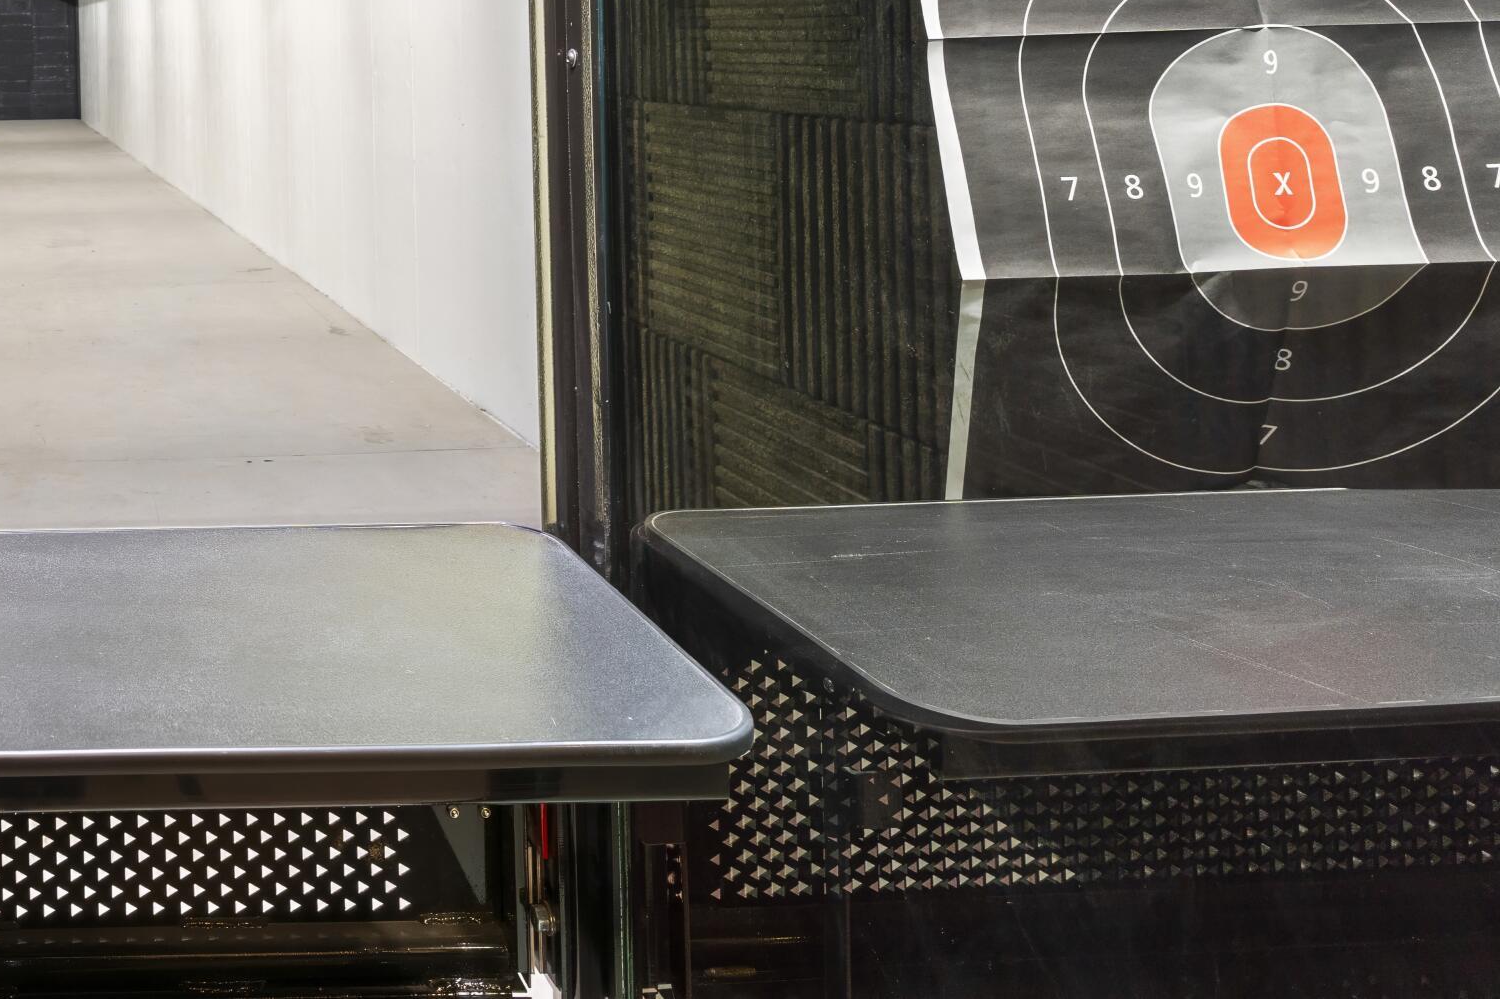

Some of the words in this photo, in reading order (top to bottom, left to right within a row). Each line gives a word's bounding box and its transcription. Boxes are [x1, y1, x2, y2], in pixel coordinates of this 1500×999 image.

[1263, 49, 1278, 74] 9
[1060, 176, 1078, 200] 7
[1123, 174, 1144, 199] 8
[1186, 173, 1203, 197] 9
[1272, 171, 1293, 195] X
[1361, 168, 1380, 193] 9
[1421, 165, 1442, 191] 8
[1485, 163, 1500, 188] 7
[1290, 280, 1308, 302] 9
[1274, 348, 1292, 371] 8
[1259, 424, 1278, 445] 7
